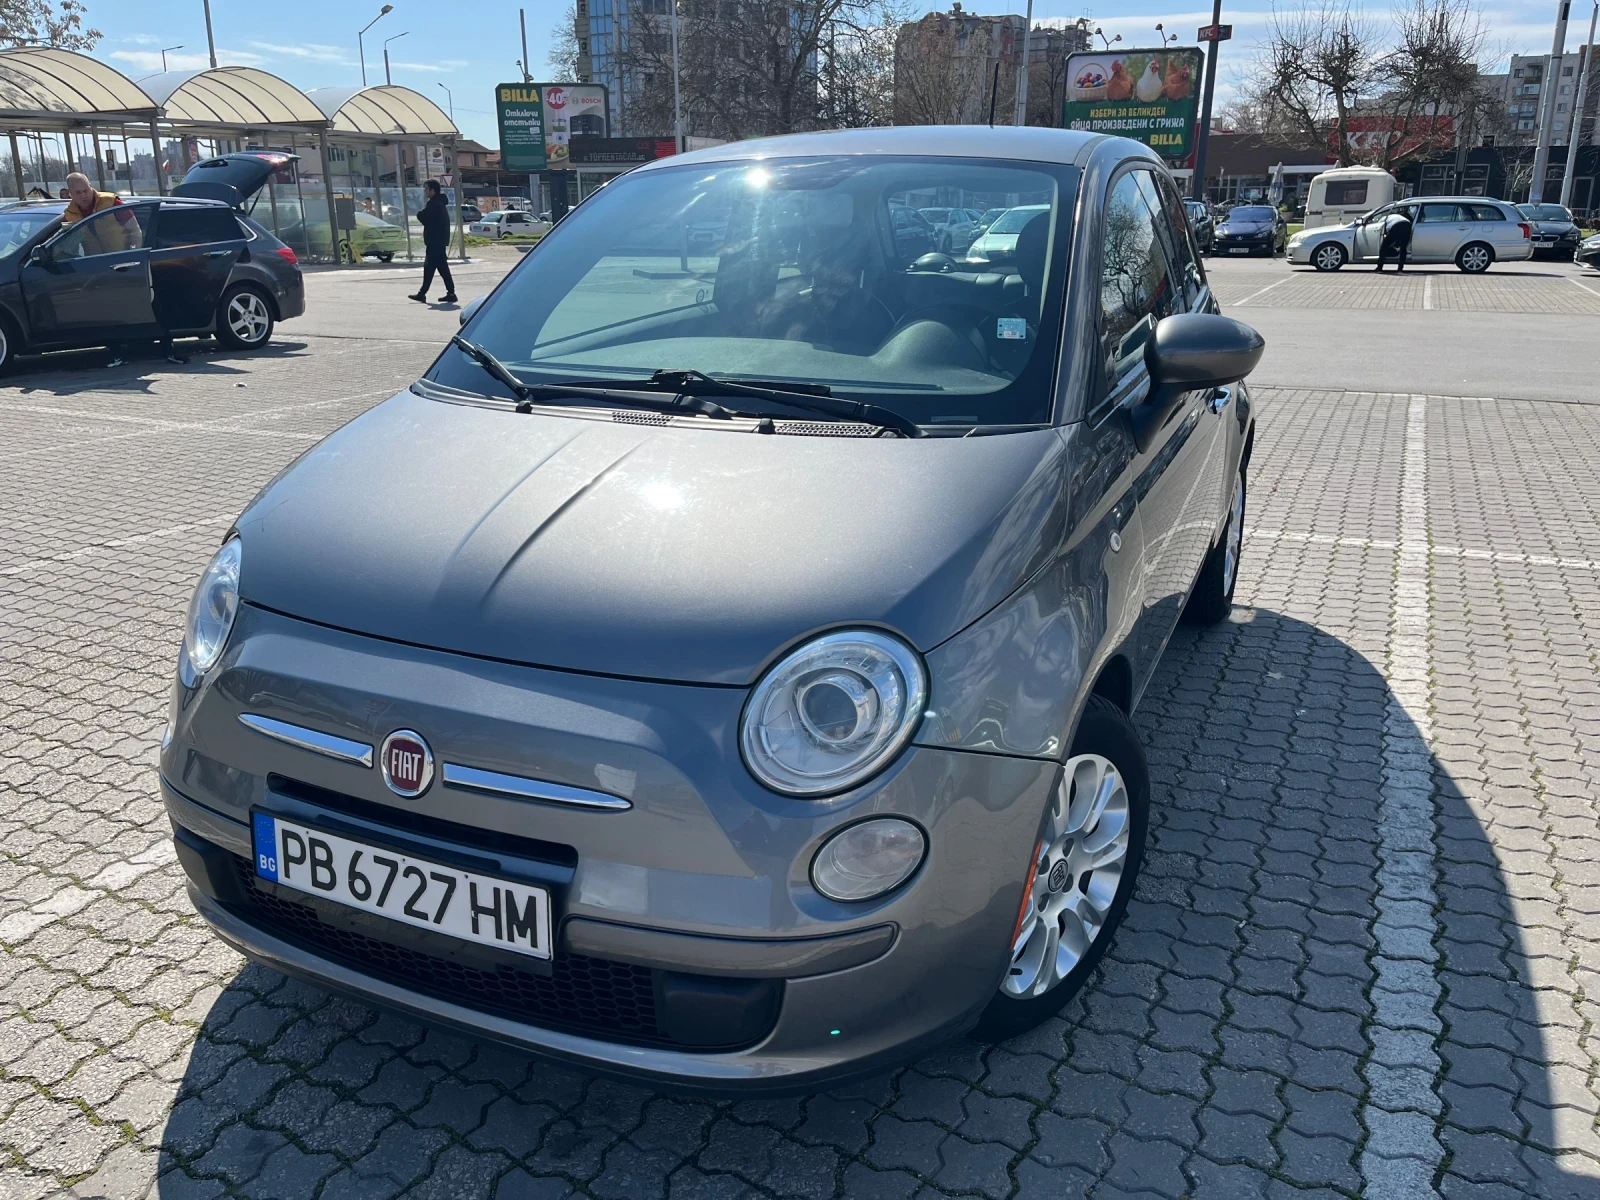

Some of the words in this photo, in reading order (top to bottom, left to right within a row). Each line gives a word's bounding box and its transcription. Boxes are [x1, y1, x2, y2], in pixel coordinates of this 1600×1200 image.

[1199, 27, 1214, 39] KFC
[500, 89, 539, 103] BILLA
[505, 109, 539, 118] Отключи
[1090, 108, 1117, 118] ИЗБЕРИ
[1118, 108, 1127, 117] ЗА
[1128, 107, 1166, 117] ВЕЛИКДЕН
[504, 118, 541, 126] отстъпки
[1070, 118, 1091, 131] ЯЙЦА
[1092, 119, 1148, 130] ПРОИЗВЕДЕНИ
[1149, 118, 1155, 129] С
[1156, 117, 1185, 128] ГРИЖА
[1150, 134, 1183, 145] BILLA
[390, 748, 422, 783] FIAT
[259, 853, 276, 873] BG
[281, 828, 337, 892] PB
[348, 850, 457, 925] 6727
[469, 881, 539, 949] HM
